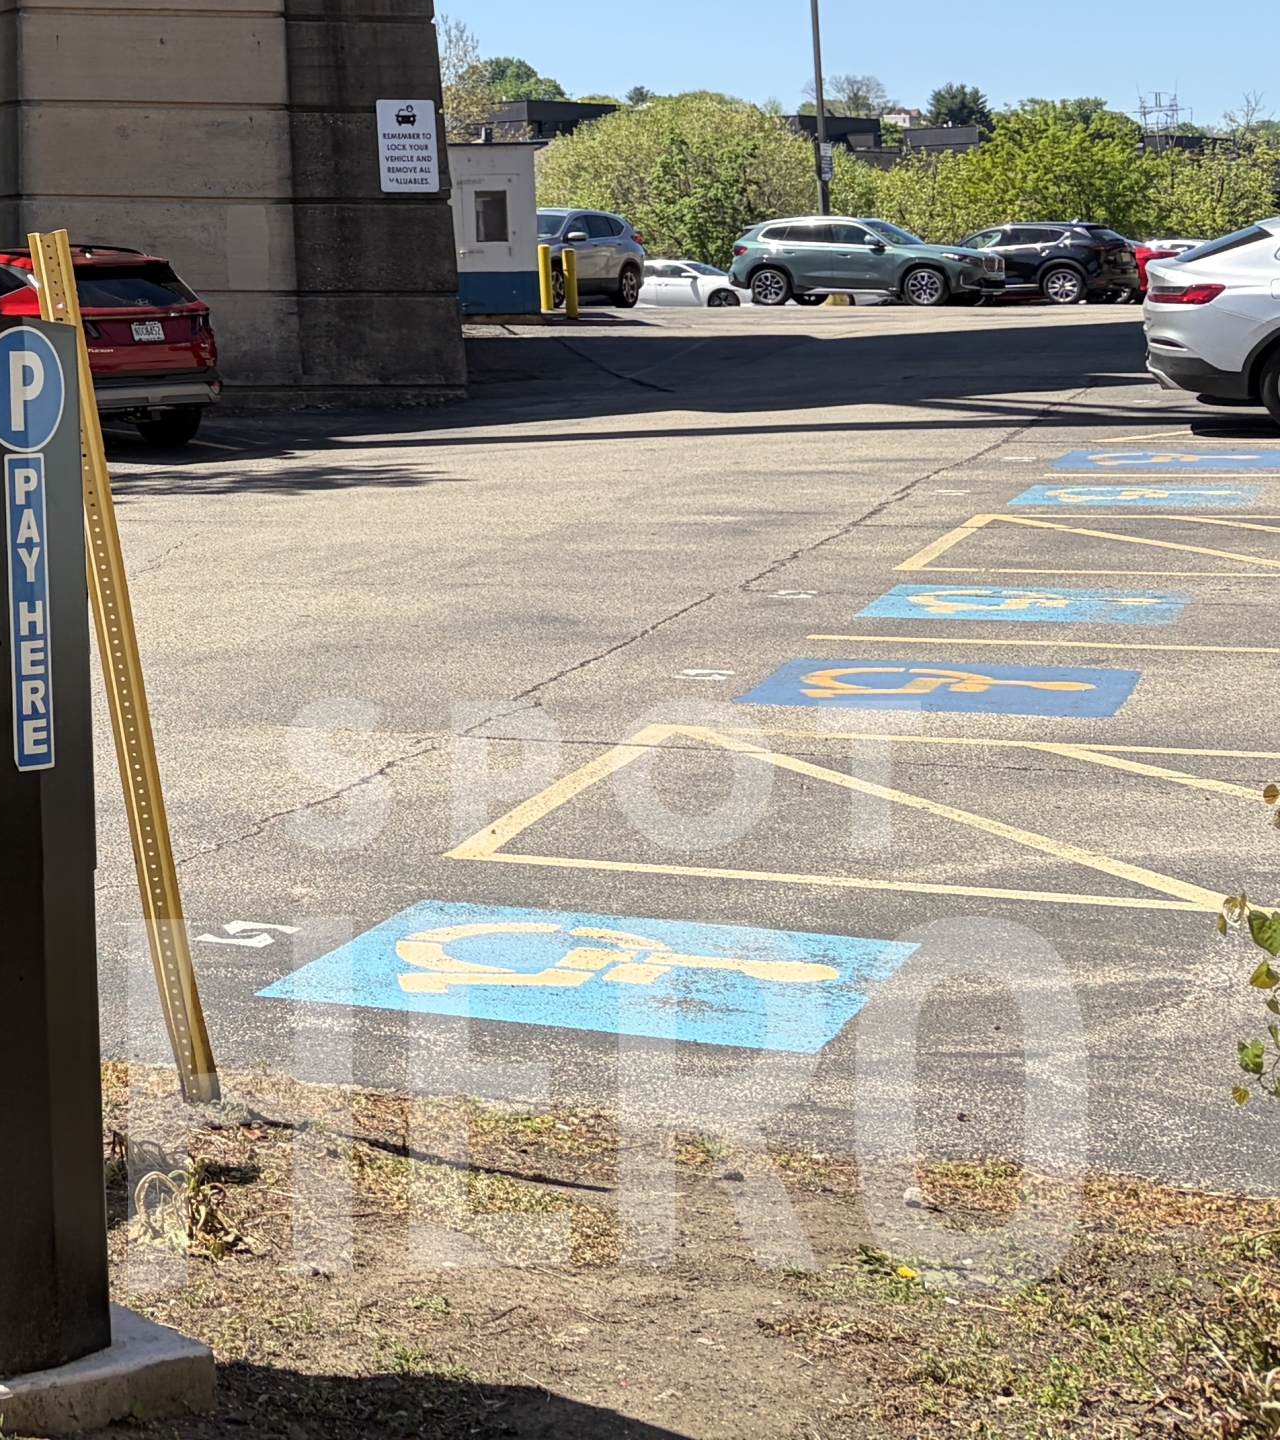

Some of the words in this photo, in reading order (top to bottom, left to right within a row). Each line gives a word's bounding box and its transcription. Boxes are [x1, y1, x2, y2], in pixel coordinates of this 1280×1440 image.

[383, 132, 420, 140] REMEMBER
[421, 132, 432, 140] TO
[387, 143, 407, 151] LOCK
[408, 143, 429, 151] YOUR
[8, 350, 45, 432] P
[14, 468, 42, 584] PAY
[19, 601, 48, 755] HERE
